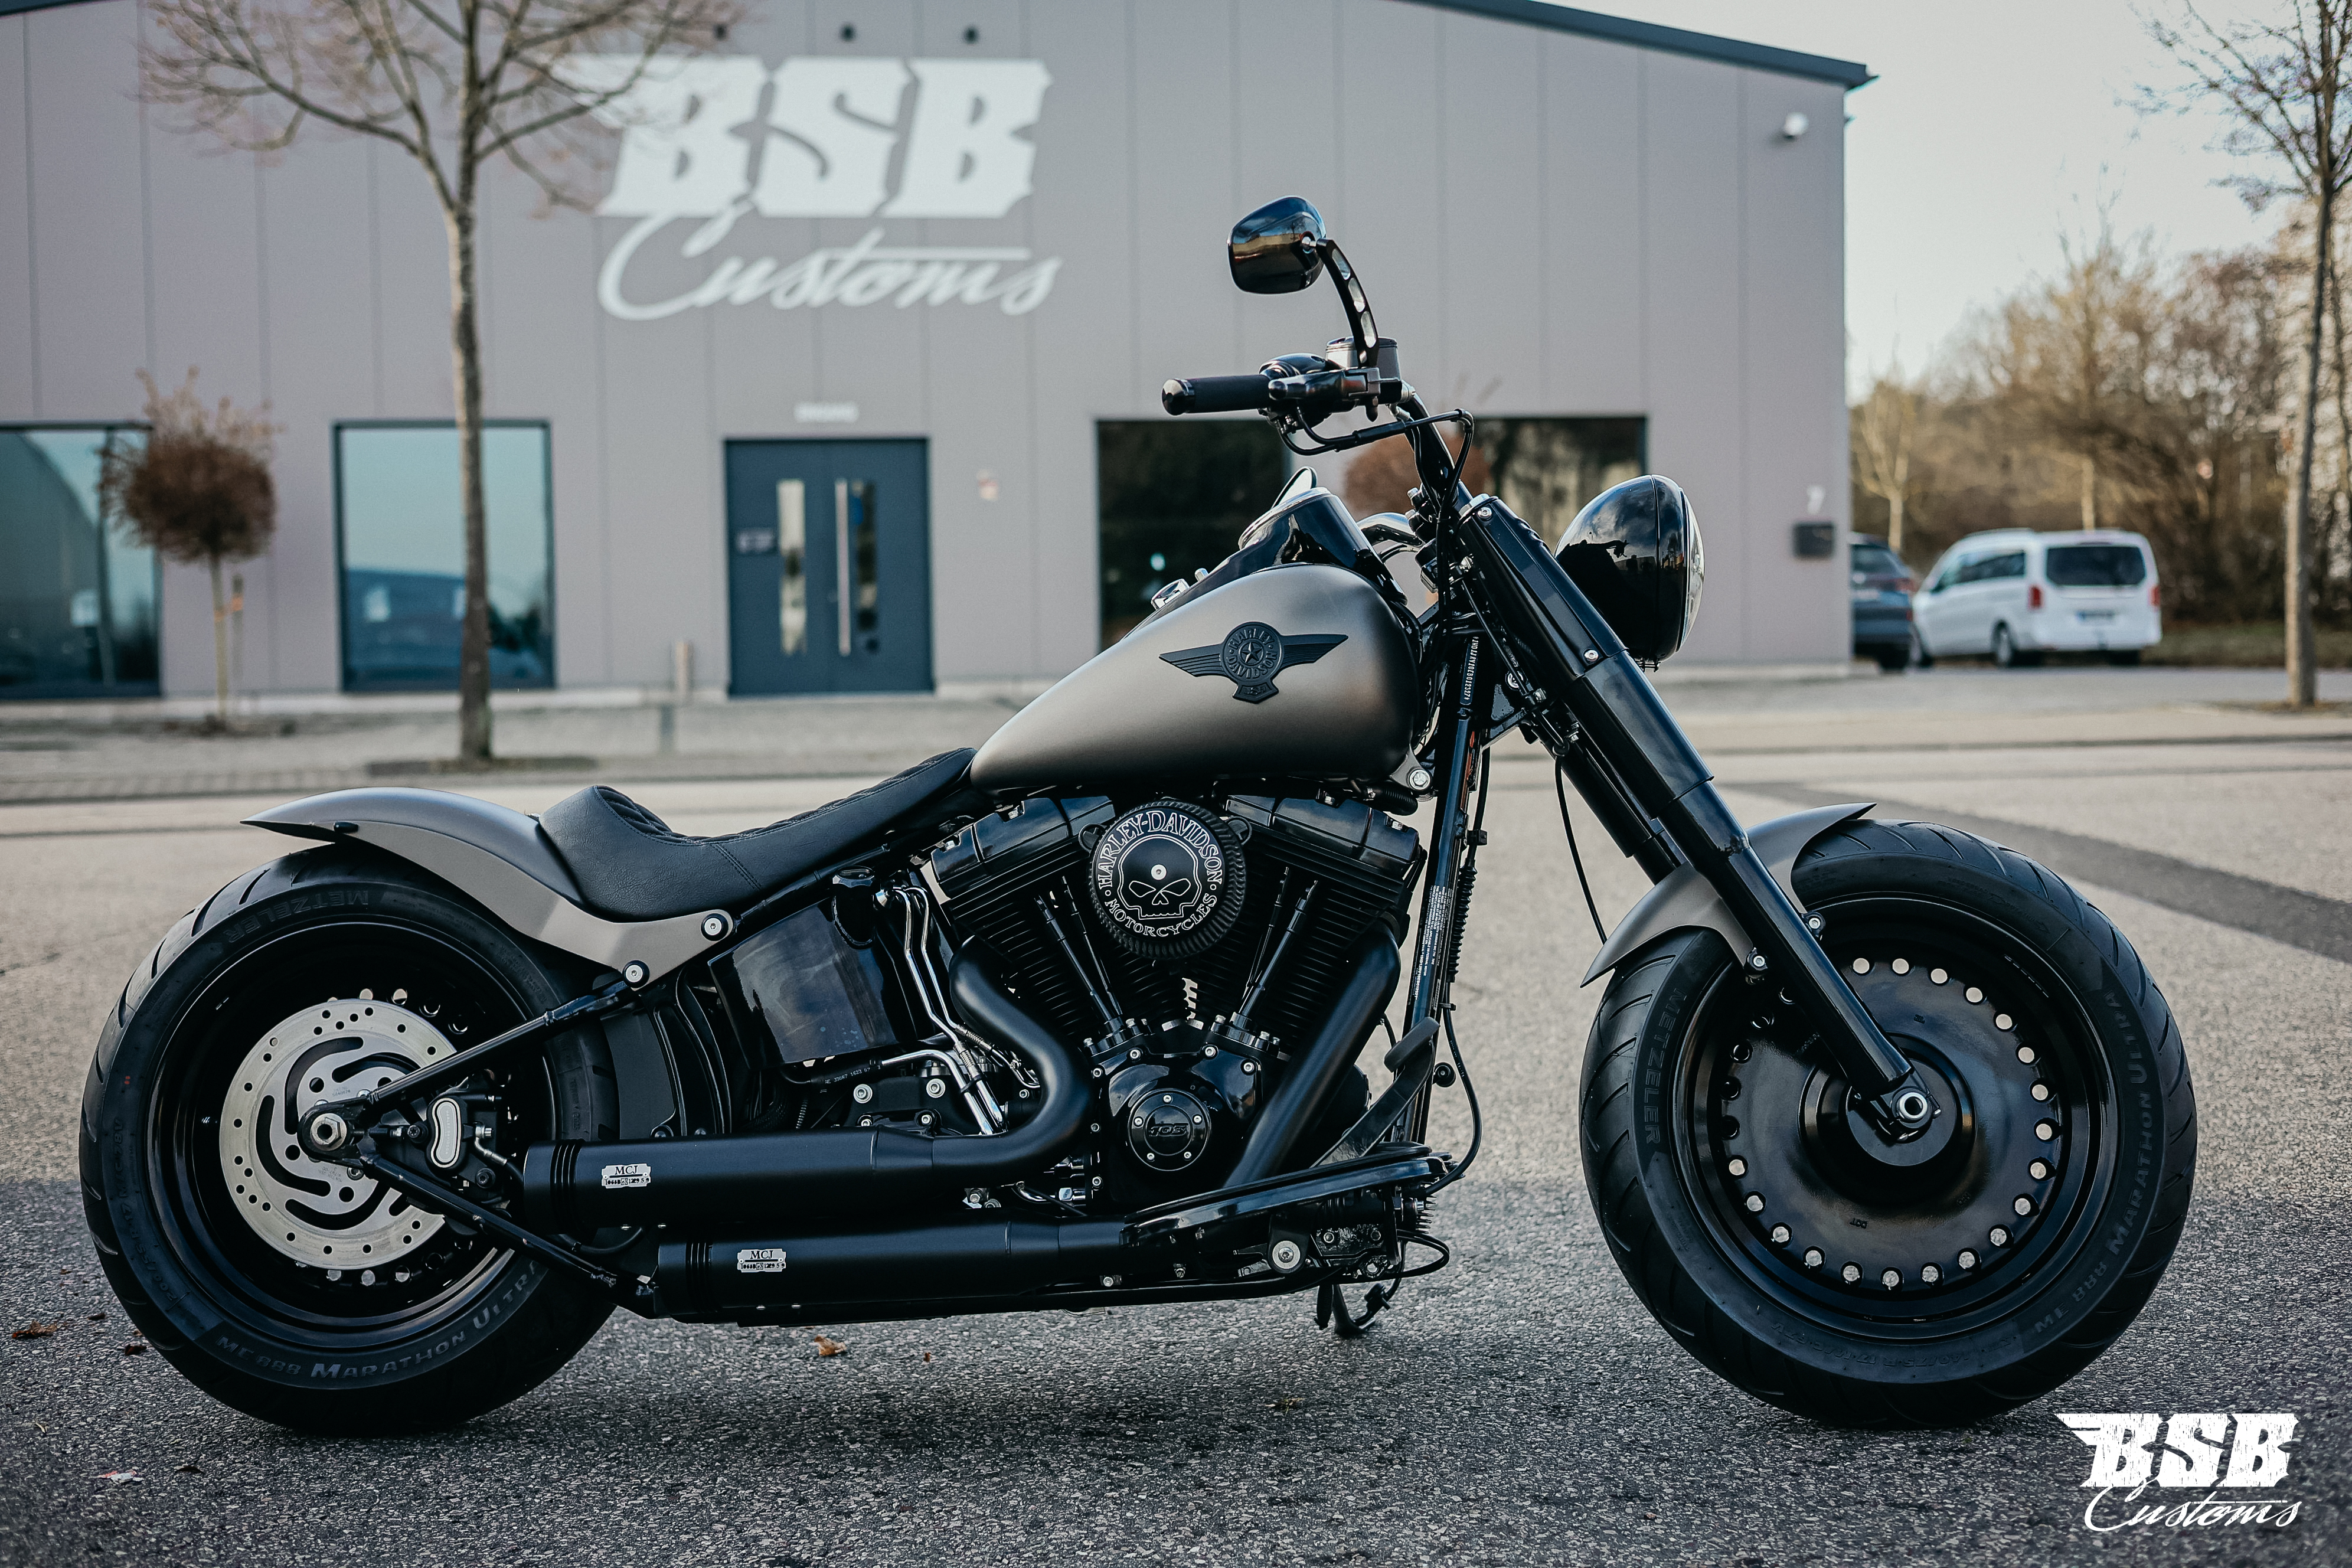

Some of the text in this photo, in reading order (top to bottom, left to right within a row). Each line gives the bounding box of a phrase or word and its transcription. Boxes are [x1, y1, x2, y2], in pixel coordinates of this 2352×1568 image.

[546, 54, 1053, 218] BSB
[597, 198, 1062, 321] Customs
[1228, 628, 1275, 649] HARLEY
[1228, 651, 1277, 679] DAVIDSON
[1098, 810, 1223, 890] HARLEY-DAVIDSON
[226, 890, 368, 945] METZELER
[1105, 893, 1217, 937] MOTORCYCLES
[1645, 987, 1687, 1145] METZELER
[1149, 1123, 1190, 1137] 103
[615, 1165, 638, 1175] MCJ
[2034, 989, 2153, 1334] ME 888 MARATHON ULTRA
[750, 1250, 773, 1259] MCJ
[217, 1334, 252, 1361] ME
[257, 1352, 300, 1377] 888
[311, 1325, 468, 1378] MARATHON
